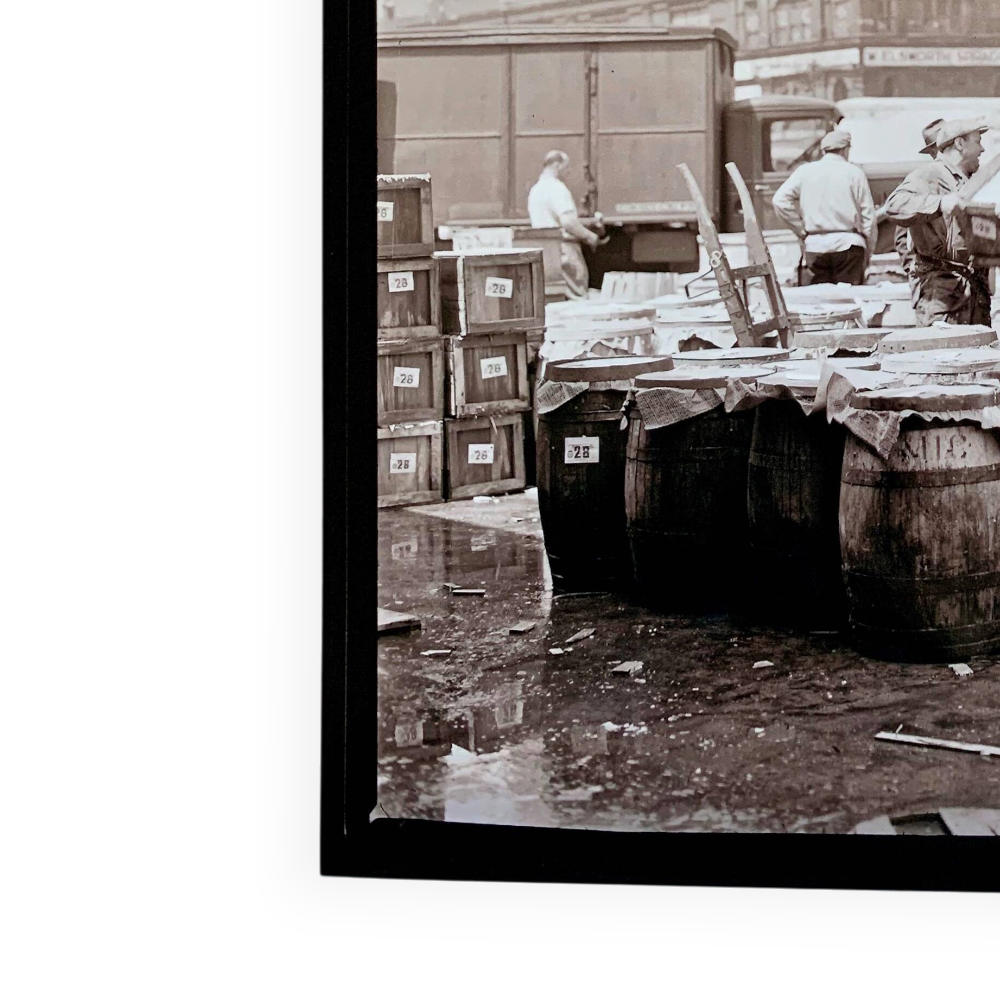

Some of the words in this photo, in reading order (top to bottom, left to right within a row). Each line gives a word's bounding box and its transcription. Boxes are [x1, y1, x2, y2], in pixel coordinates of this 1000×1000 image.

[394, 278, 408, 289] 28
[491, 283, 506, 295] 28
[487, 363, 502, 375] 28
[400, 373, 414, 384] 28
[474, 450, 488, 461] 28
[573, 445, 590, 459] 28
[397, 459, 410, 470] 28
